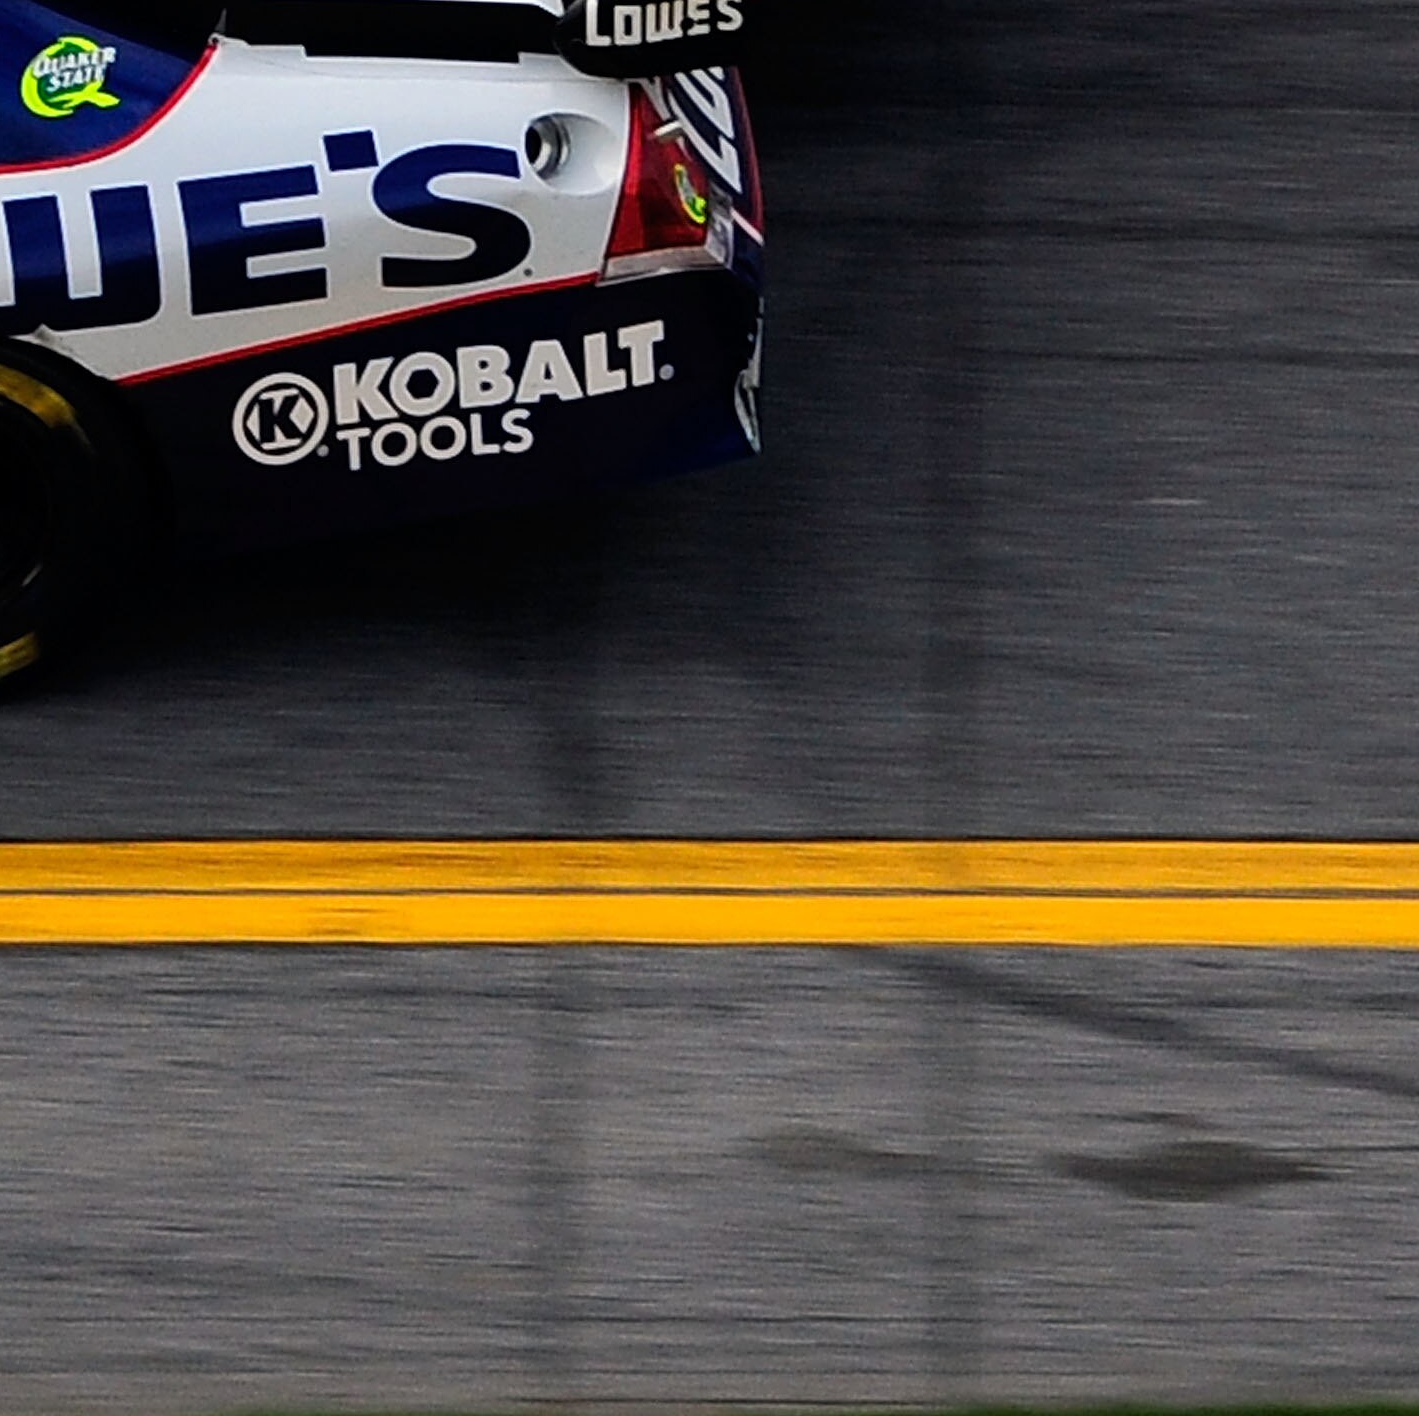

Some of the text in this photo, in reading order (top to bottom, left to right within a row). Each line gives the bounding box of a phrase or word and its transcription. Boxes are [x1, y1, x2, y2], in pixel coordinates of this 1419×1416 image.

[31, 46, 117, 80] QUAKER
[45, 64, 105, 93] STATE
[333, 319, 664, 426] KOBALT
[336, 408, 534, 471] TOOLS
